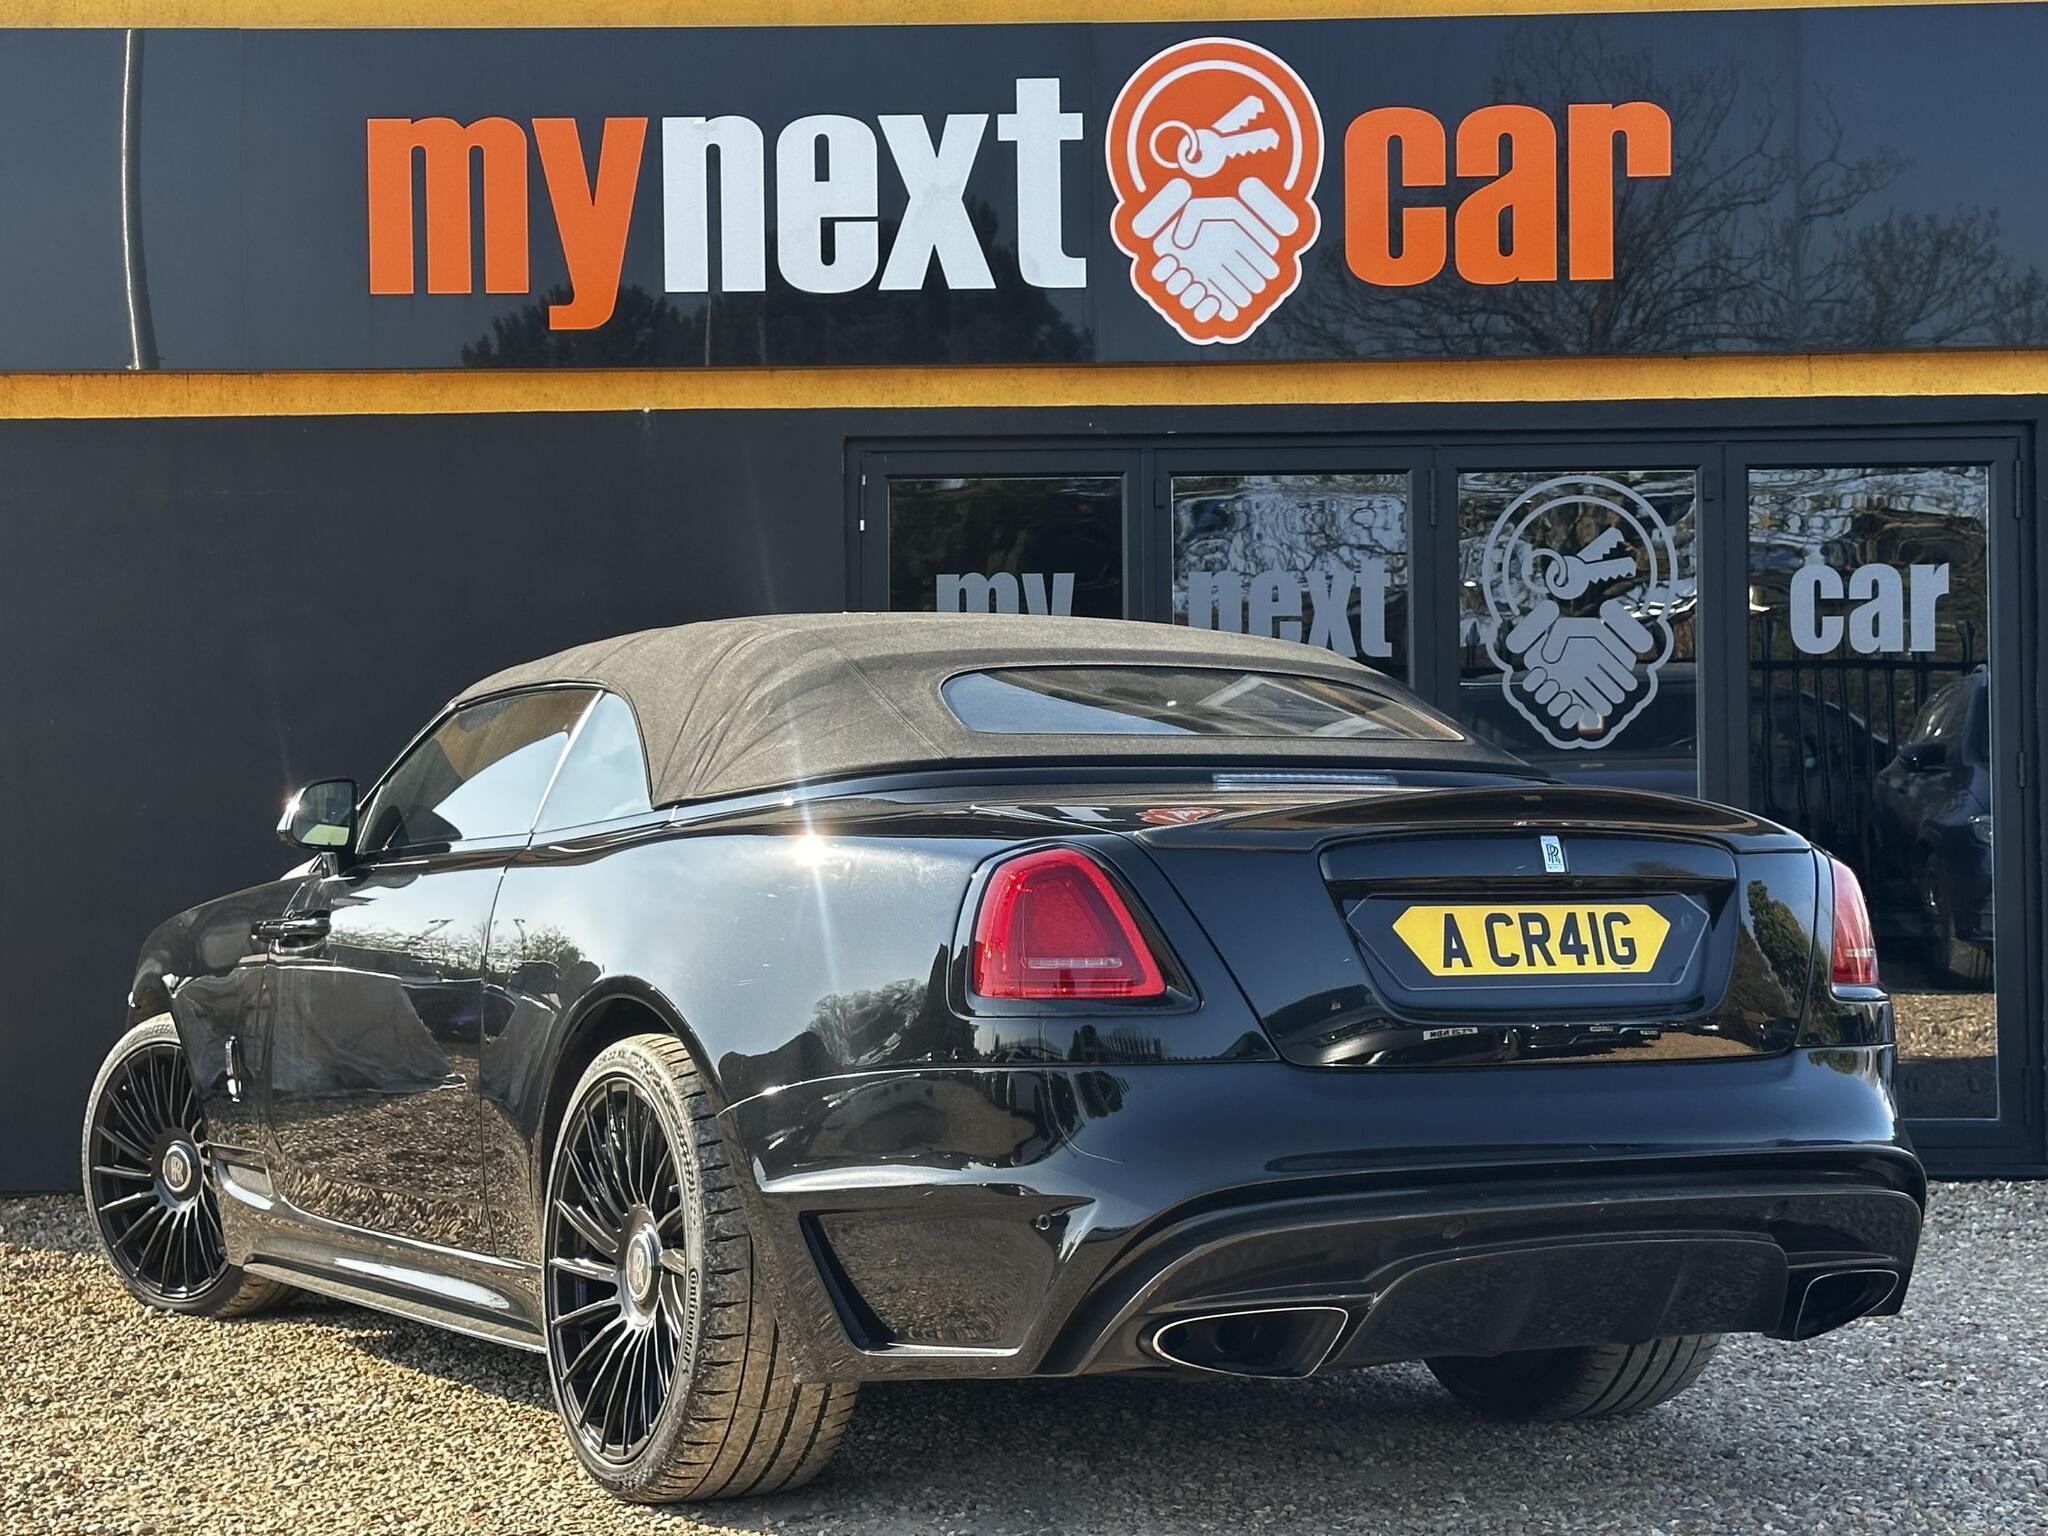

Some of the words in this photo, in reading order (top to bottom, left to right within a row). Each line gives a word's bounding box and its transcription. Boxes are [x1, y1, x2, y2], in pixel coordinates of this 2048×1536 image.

[1344, 101, 1672, 287] car
[1188, 557, 1393, 658] next
[1790, 562, 1950, 655] car
[1443, 913, 1473, 968] A
